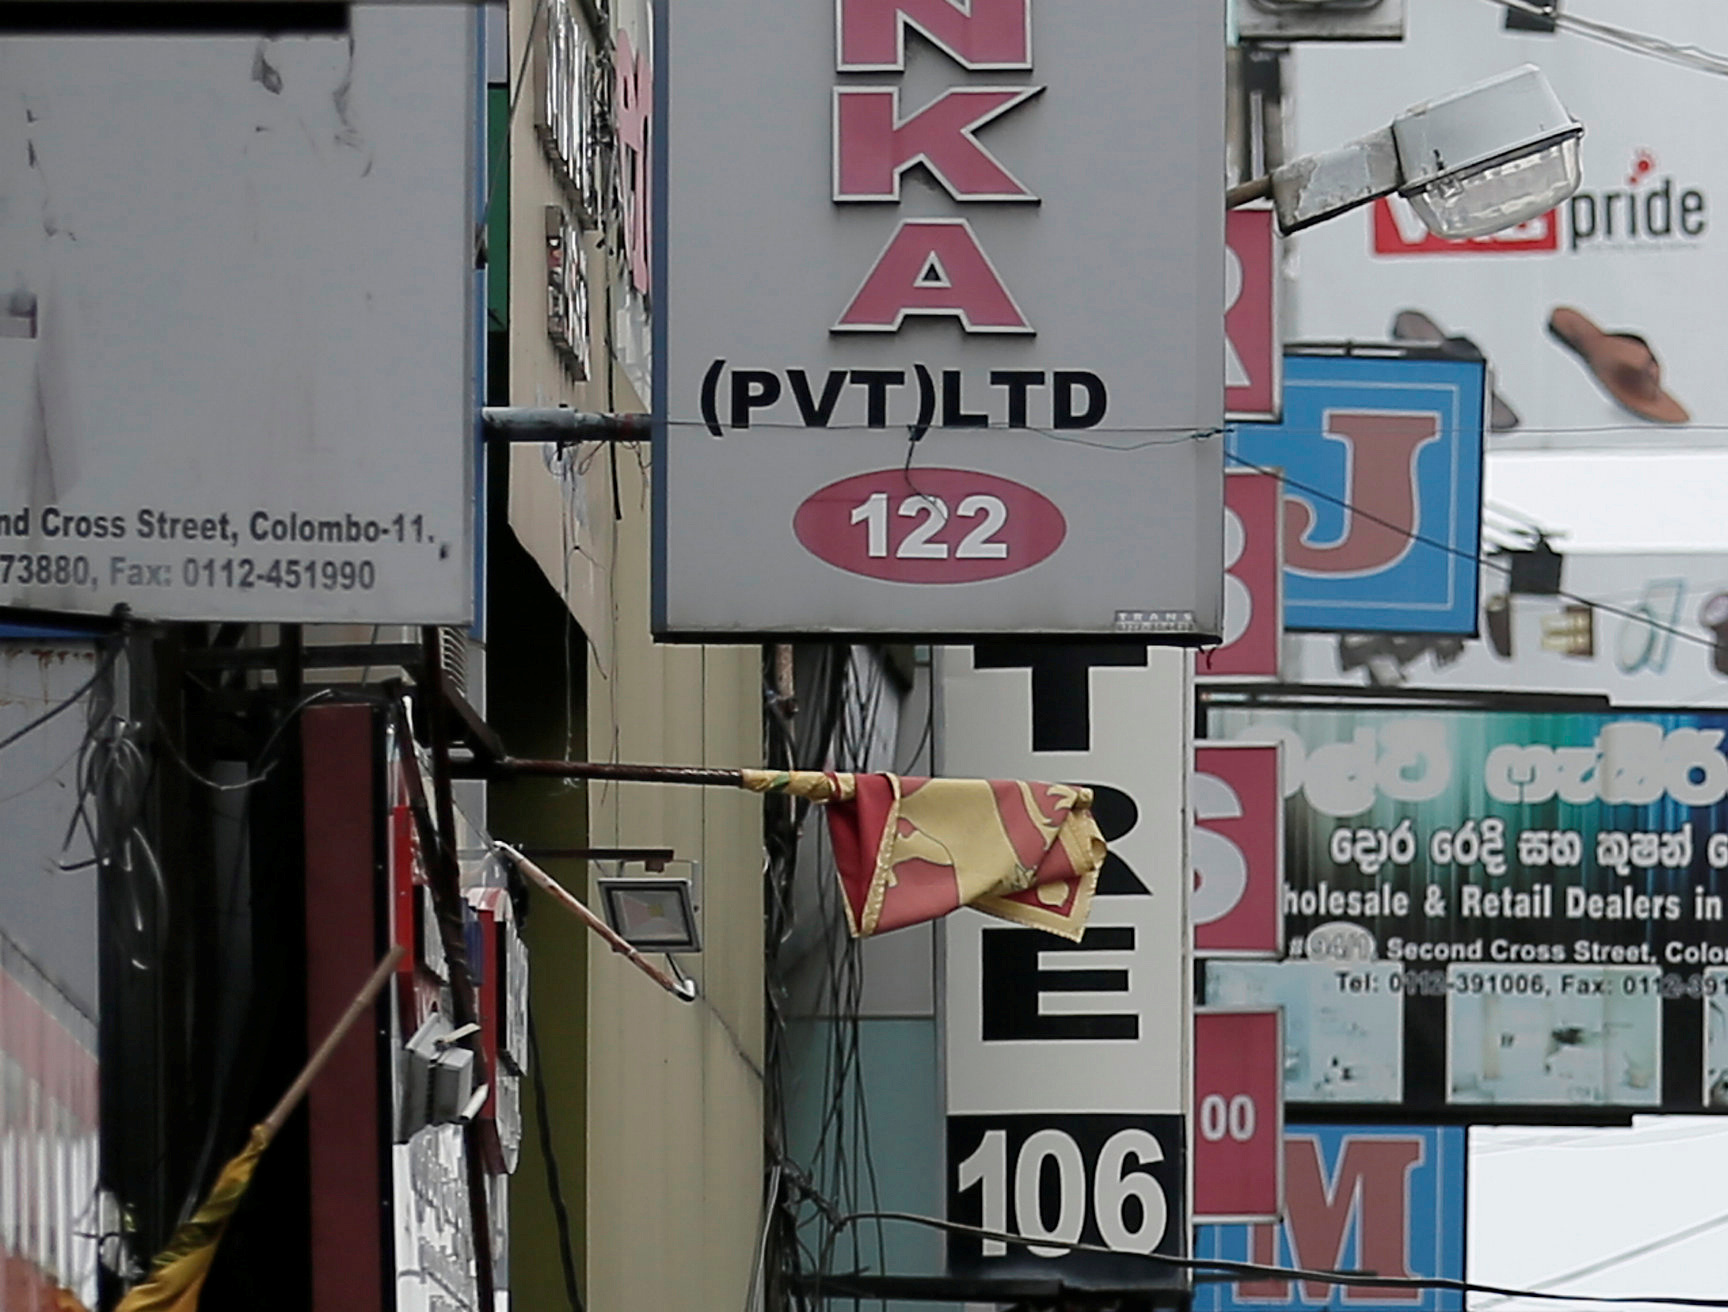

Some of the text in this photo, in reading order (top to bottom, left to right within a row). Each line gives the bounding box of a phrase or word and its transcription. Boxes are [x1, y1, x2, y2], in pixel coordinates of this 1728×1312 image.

[1570, 172, 1705, 250] pride
[41, 508, 129, 541] Cross
[136, 510, 239, 547] Street,
[250, 512, 435, 546] Colombo-11.
[850, 493, 1007, 558] 122
[109, 555, 172, 588] Fax:
[183, 557, 375, 591] 0112-451990
[1284, 882, 1409, 917] holesale
[1424, 884, 1446, 917] &
[1462, 884, 1551, 918] Retail
[1566, 886, 1681, 920] Dealers
[1695, 886, 1722, 920] in
[1387, 938, 1482, 961] Second
[1491, 940, 1565, 962] Cross
[1336, 972, 1379, 993] Tel:
[1561, 974, 1612, 995] Fax:
[957, 1127, 1168, 1259] 106
